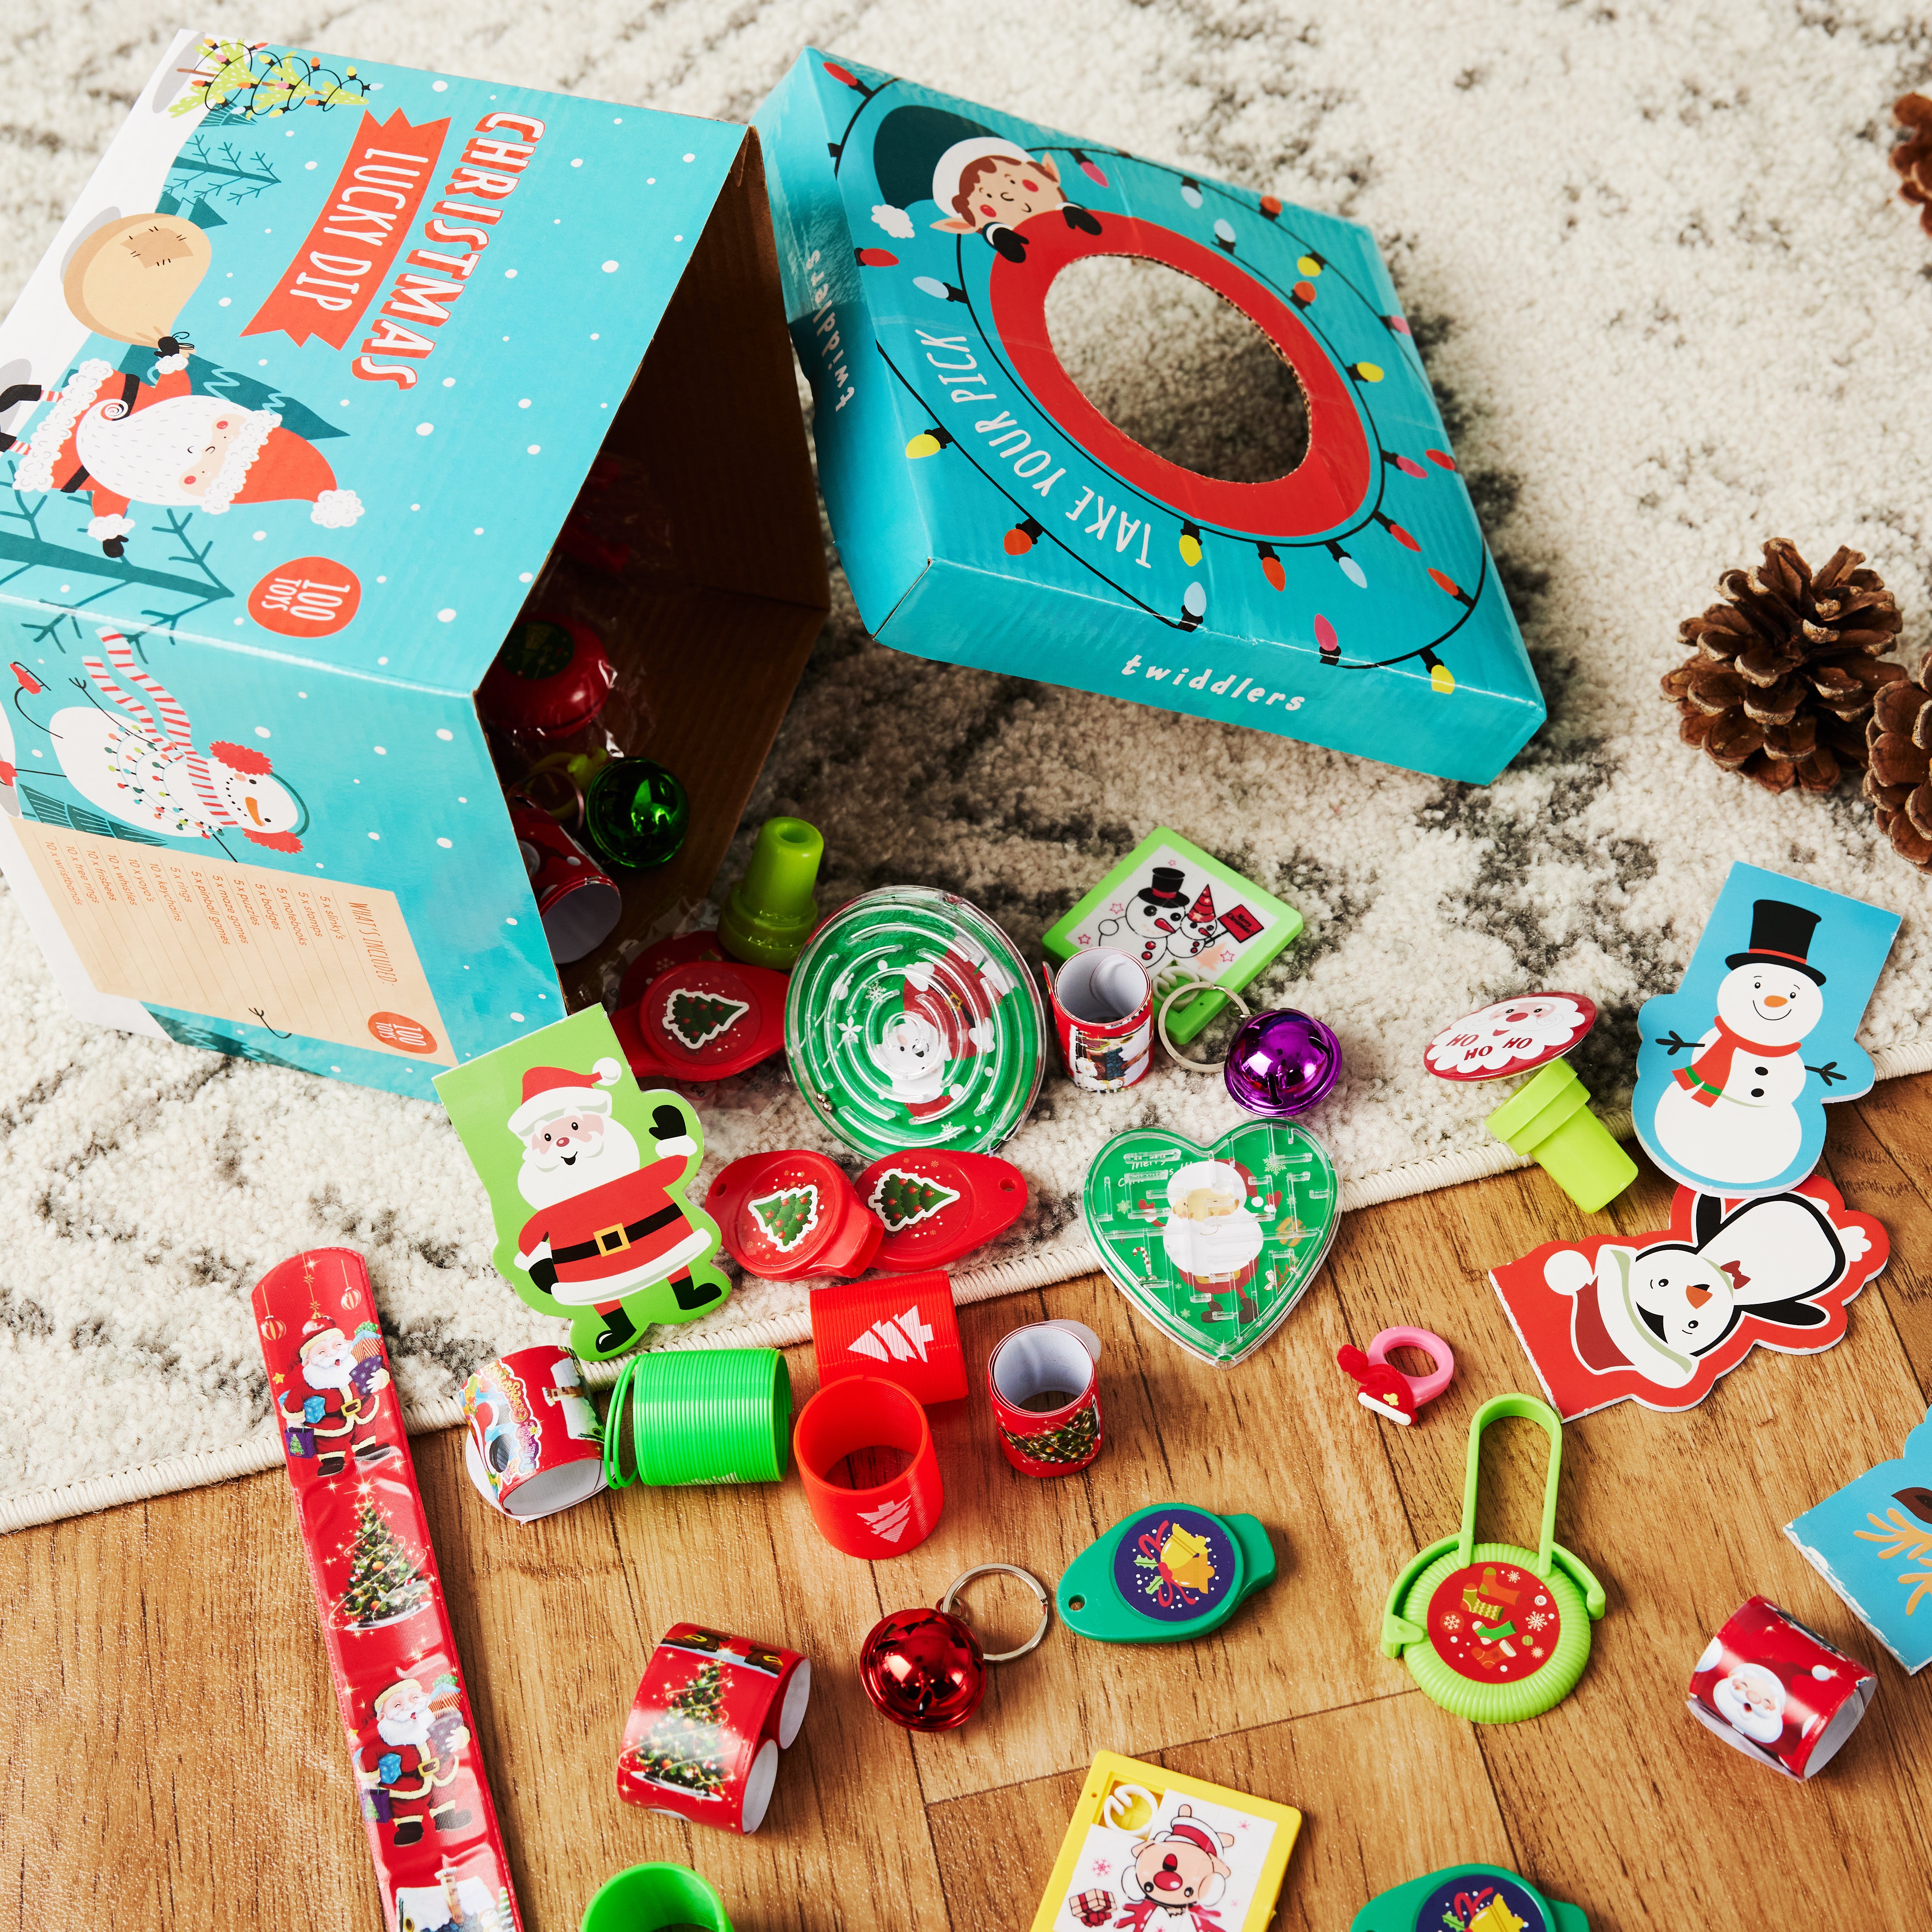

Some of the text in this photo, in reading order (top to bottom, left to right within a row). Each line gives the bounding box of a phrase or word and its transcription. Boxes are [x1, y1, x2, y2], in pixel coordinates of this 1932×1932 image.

[290, 148, 429, 311] LUCKY DIP
[352, 112, 545, 390] CHRISTMAS
[806, 250, 855, 412] twiddlers
[915, 329, 1152, 568] TAKE YOUR PICK
[261, 577, 302, 611] TOYS
[290, 579, 350, 621] 100
[1121, 654, 1305, 711] twiddlers
[55, 859, 82, 906] wristbands
[66, 846, 77, 855] 10
[75, 864, 88, 881] tree
[83, 883, 99, 904] rings
[87, 850, 99, 859] 10
[95, 867, 116, 902] frisbees
[107, 854, 119, 863] 10
[116, 872, 137, 906] whistles
[128, 859, 140, 868] 10
[134, 875, 156, 902] yoyo's
[149, 863, 161, 872] 10
[157, 880, 182, 922] keychains
[177, 880, 192, 903] rings
[195, 884, 220, 915] pinball
[209, 916, 230, 945] games
[219, 889, 235, 914] maze
[227, 914, 249, 944] games
[237, 893, 259, 926] puzzles
[261, 898, 281, 930] badges
[283, 901, 307, 946] notebooks
[304, 906, 323, 938] stamps
[326, 910, 346, 940] slinky's
[348, 901, 398, 986] WHAT'S INCLUDED:
[375, 1022, 398, 1040] TOYS
[393, 1023, 427, 1046] 100
[1446, 1034, 1479, 1047] HO
[1464, 1046, 1493, 1061] HO
[1502, 1038, 1533, 1049] HO
